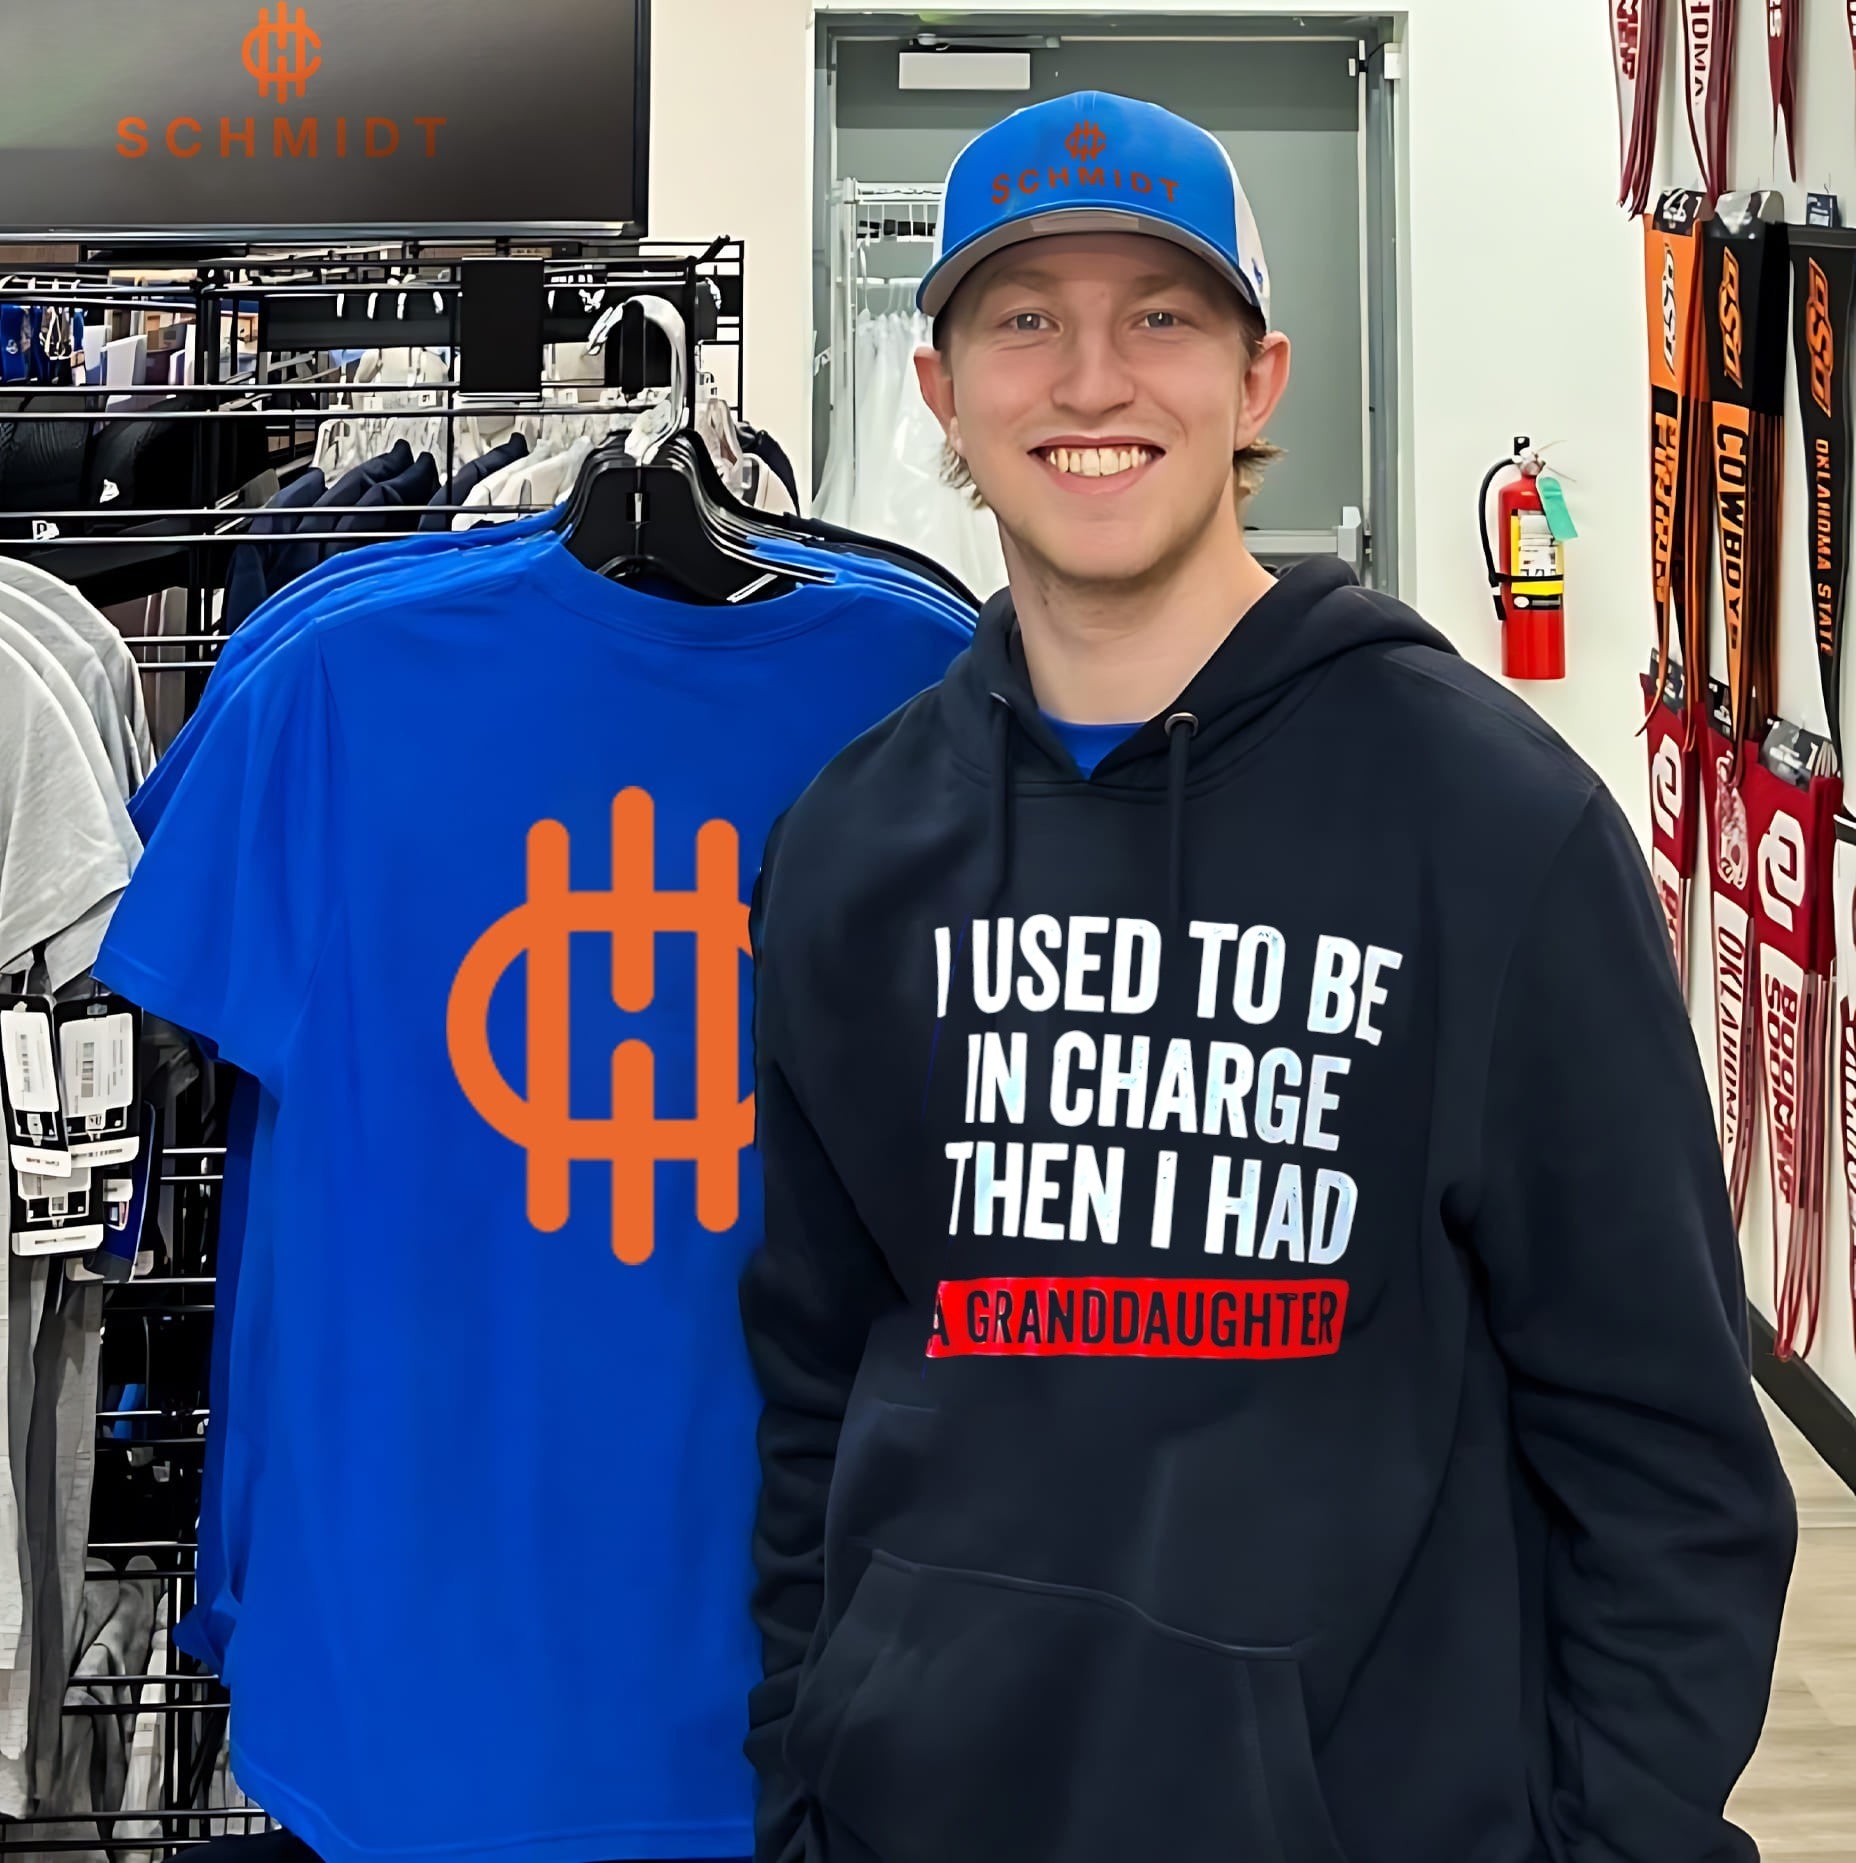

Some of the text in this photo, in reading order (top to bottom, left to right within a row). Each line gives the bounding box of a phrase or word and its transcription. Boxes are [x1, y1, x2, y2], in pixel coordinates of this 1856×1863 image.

[115, 116, 447, 159] SCHMIDT
[991, 167, 1179, 204] SCHMIDT
[1815, 438, 1832, 571] OKLAHOMA
[934, 914, 1404, 1046] I USED TO BE
[964, 1030, 1352, 1152] IN CHARGE
[944, 1141, 1359, 1265] THEN I HAD
[966, 1289, 1338, 1348] GRANDDAUGHTER
